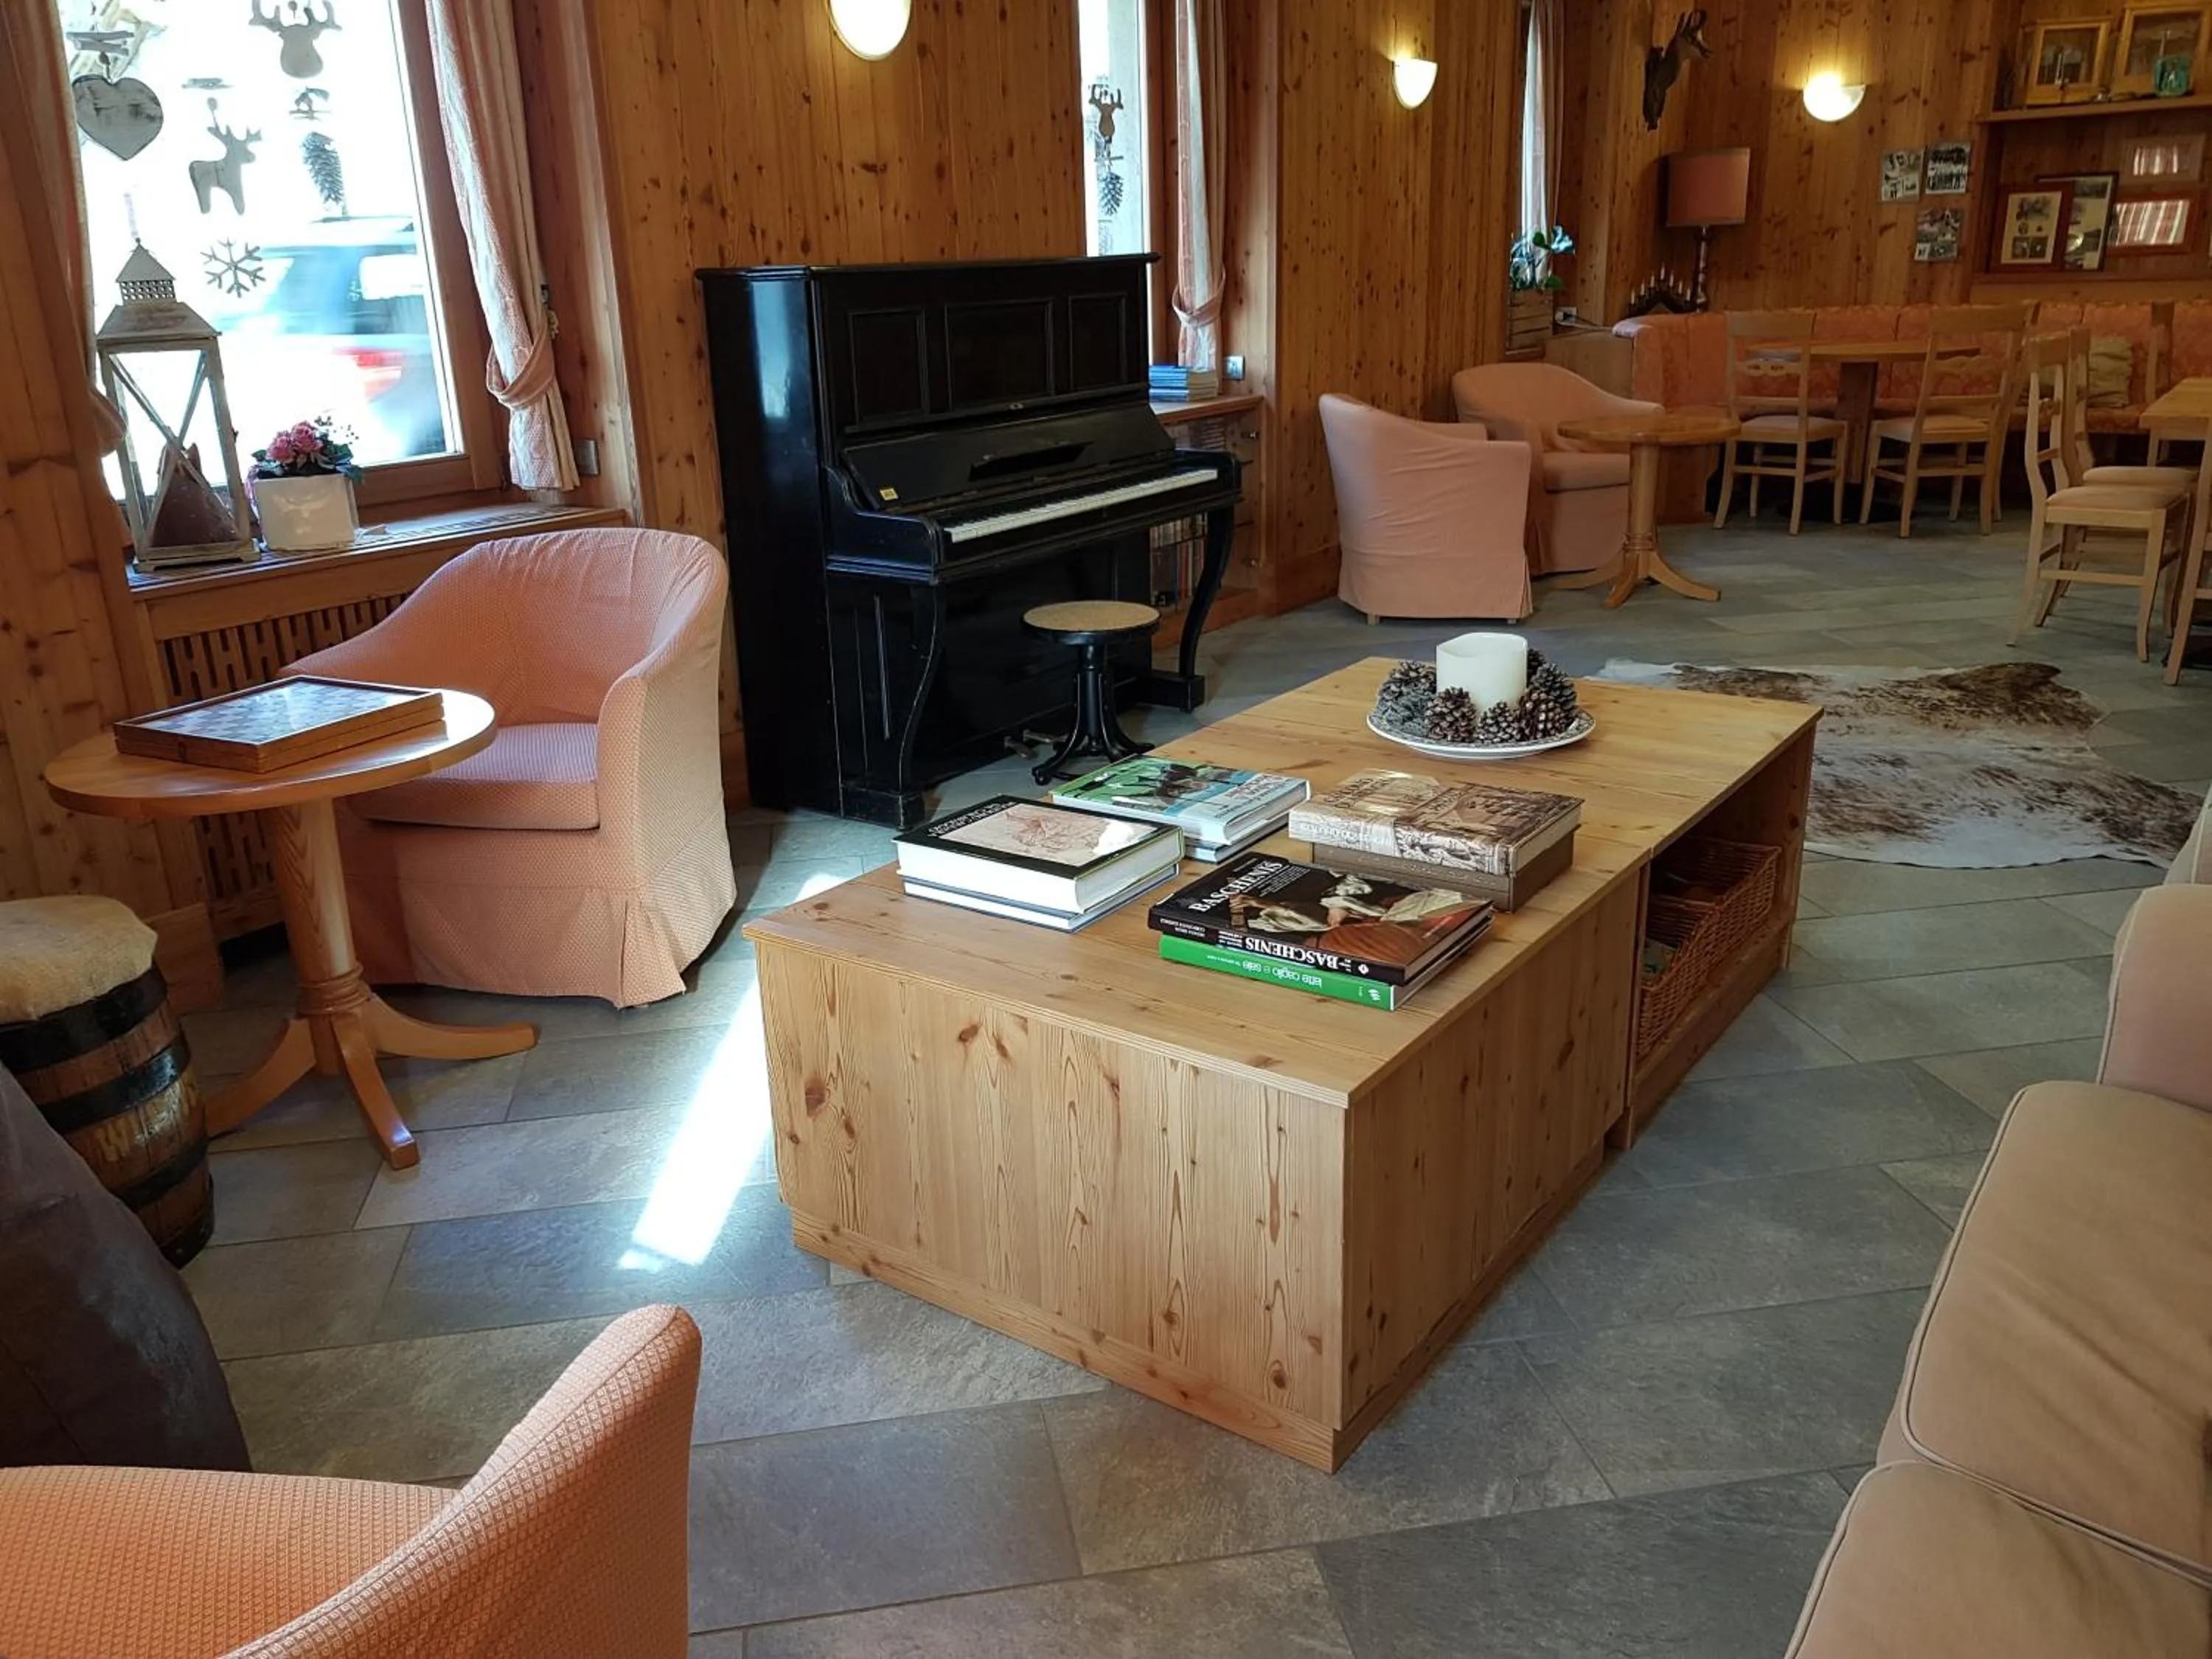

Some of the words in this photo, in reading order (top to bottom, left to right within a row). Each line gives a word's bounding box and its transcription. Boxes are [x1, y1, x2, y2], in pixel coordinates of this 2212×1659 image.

[1188, 860, 1283, 912] BASCHENIS
[1245, 937, 1339, 970] BASCHENIS
[1242, 960, 1262, 973] sale
[1272, 967, 1300, 982] caglio
[1302, 973, 1322, 989] latte
